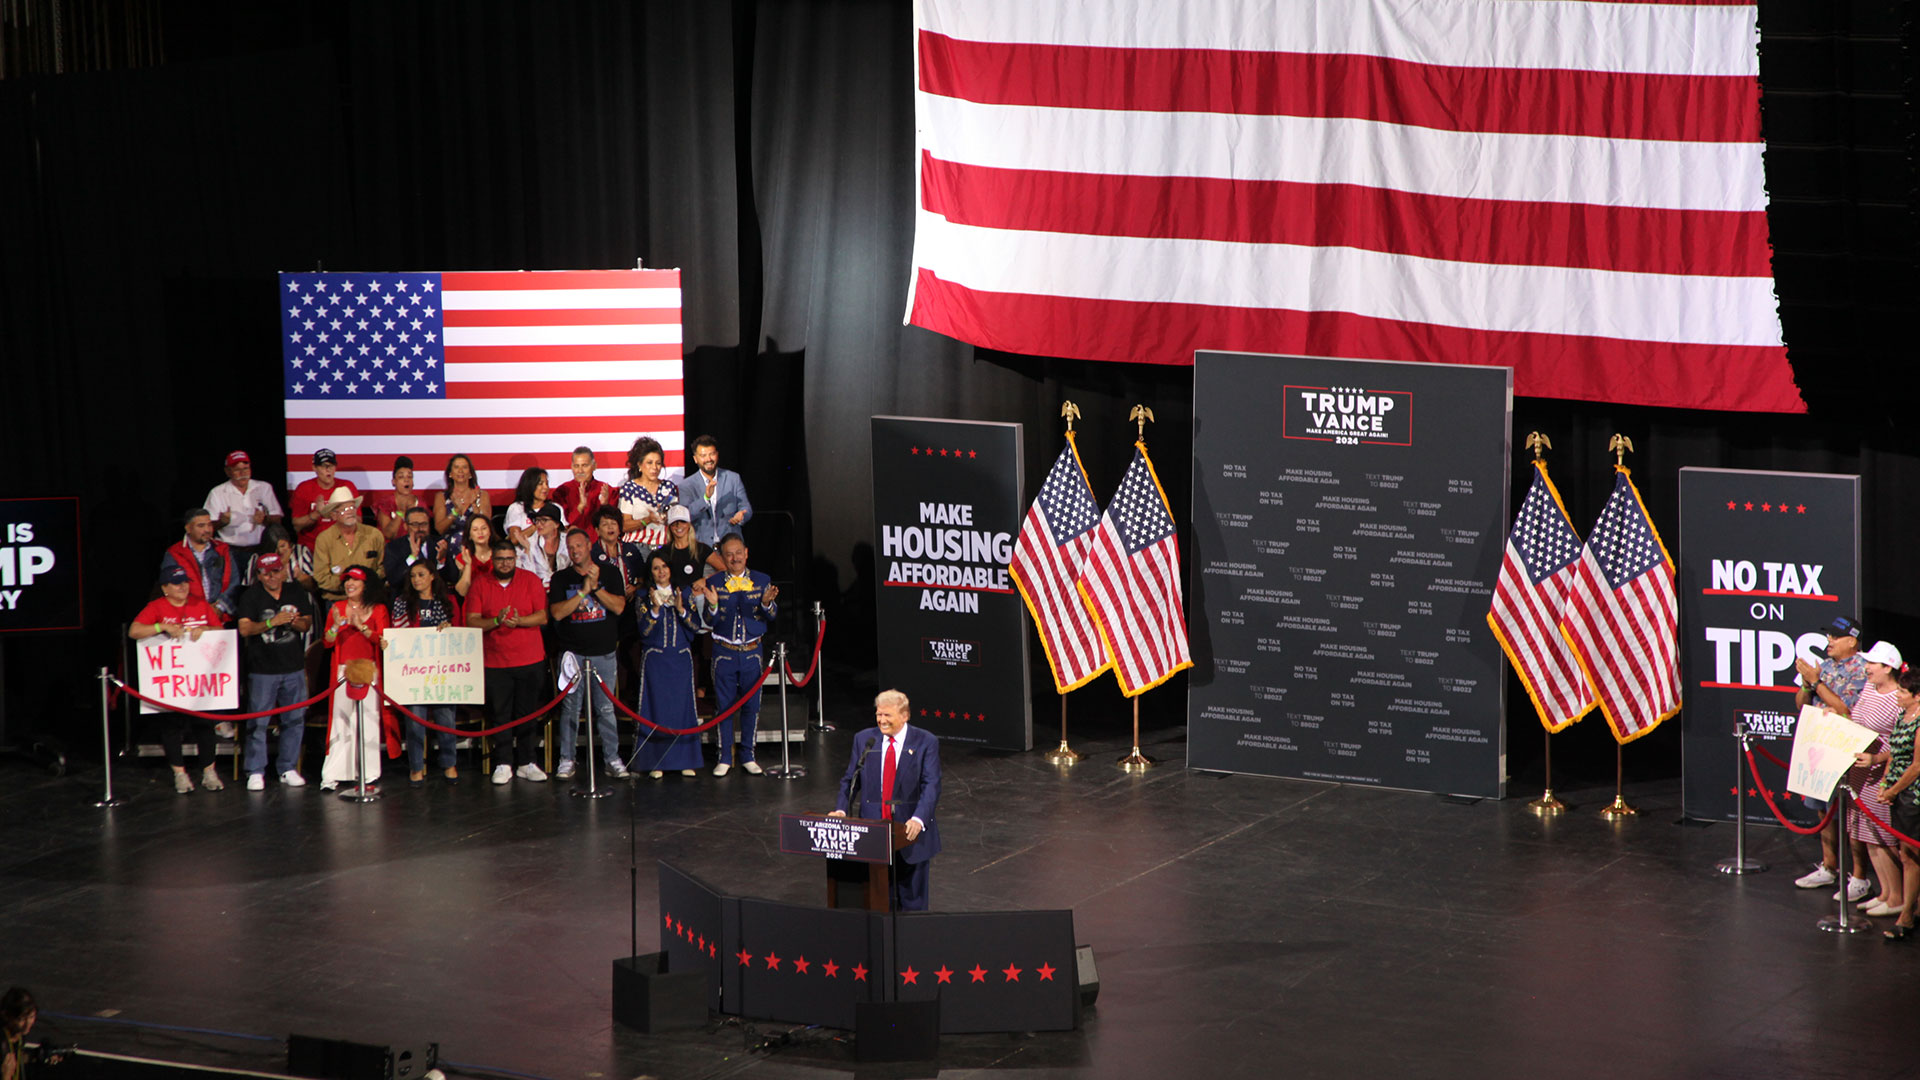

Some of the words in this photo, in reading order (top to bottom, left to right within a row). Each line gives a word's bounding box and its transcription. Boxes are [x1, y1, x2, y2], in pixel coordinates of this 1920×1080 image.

[1301, 392, 1394, 415] TRUMP
[1312, 412, 1383, 432] VANCE
[1335, 437, 1358, 445] 2024
[1278, 474, 1319, 483] AFFORDABLE
[1382, 474, 1404, 482] TRUMP
[1342, 497, 1370, 505] HOUSING
[1315, 502, 1356, 510] AFFORDABLE
[919, 501, 973, 526] MAKE
[1232, 513, 1253, 521] TRUMP
[1378, 524, 1407, 532] HOUSING
[7, 523, 34, 543] IS
[1352, 529, 1393, 538] AFFORDABLE
[882, 525, 1013, 564] HOUSING
[1229, 562, 1257, 570] HOUSING
[888, 561, 1009, 590] AFFORDABLE
[1203, 567, 1243, 576] AFFORDABLE
[1455, 578, 1484, 586] HOUSING
[1711, 559, 1757, 592] NO
[1763, 561, 1824, 596] TAX
[1428, 583, 1470, 592] AFFORDABLE
[0, 590, 22, 610] Y
[919, 589, 978, 614] AGAIN
[1750, 602, 1784, 621] ON
[1302, 617, 1330, 625] HOUSING
[1276, 622, 1316, 630] AFFORDABLE
[389, 632, 476, 662] LATINO
[929, 641, 972, 653] TRUMP
[1339, 644, 1367, 652] HOUSING
[145, 645, 185, 671] WE
[934, 650, 968, 659] VANCE
[1313, 649, 1353, 658] AFFORDABLE
[1705, 627, 1831, 688] TIPS
[401, 660, 471, 676] Americans
[152, 672, 231, 699] TRUMP
[1455, 678, 1477, 686] TRUMP
[409, 684, 474, 702] TRUMP
[1387, 704, 1429, 713] AFFORDABLE
[1200, 712, 1240, 721] AFFORDABLE
[1743, 713, 1795, 726] TRUMP
[1749, 723, 1790, 733] VANCE
[1237, 740, 1277, 749] AFFORDABLE
[799, 819, 814, 827] TEXT
[815, 821, 840, 830] ARIZONA
[807, 827, 861, 843] TRUMP
[813, 838, 855, 851] VANCE
[826, 852, 843, 860] 2024
